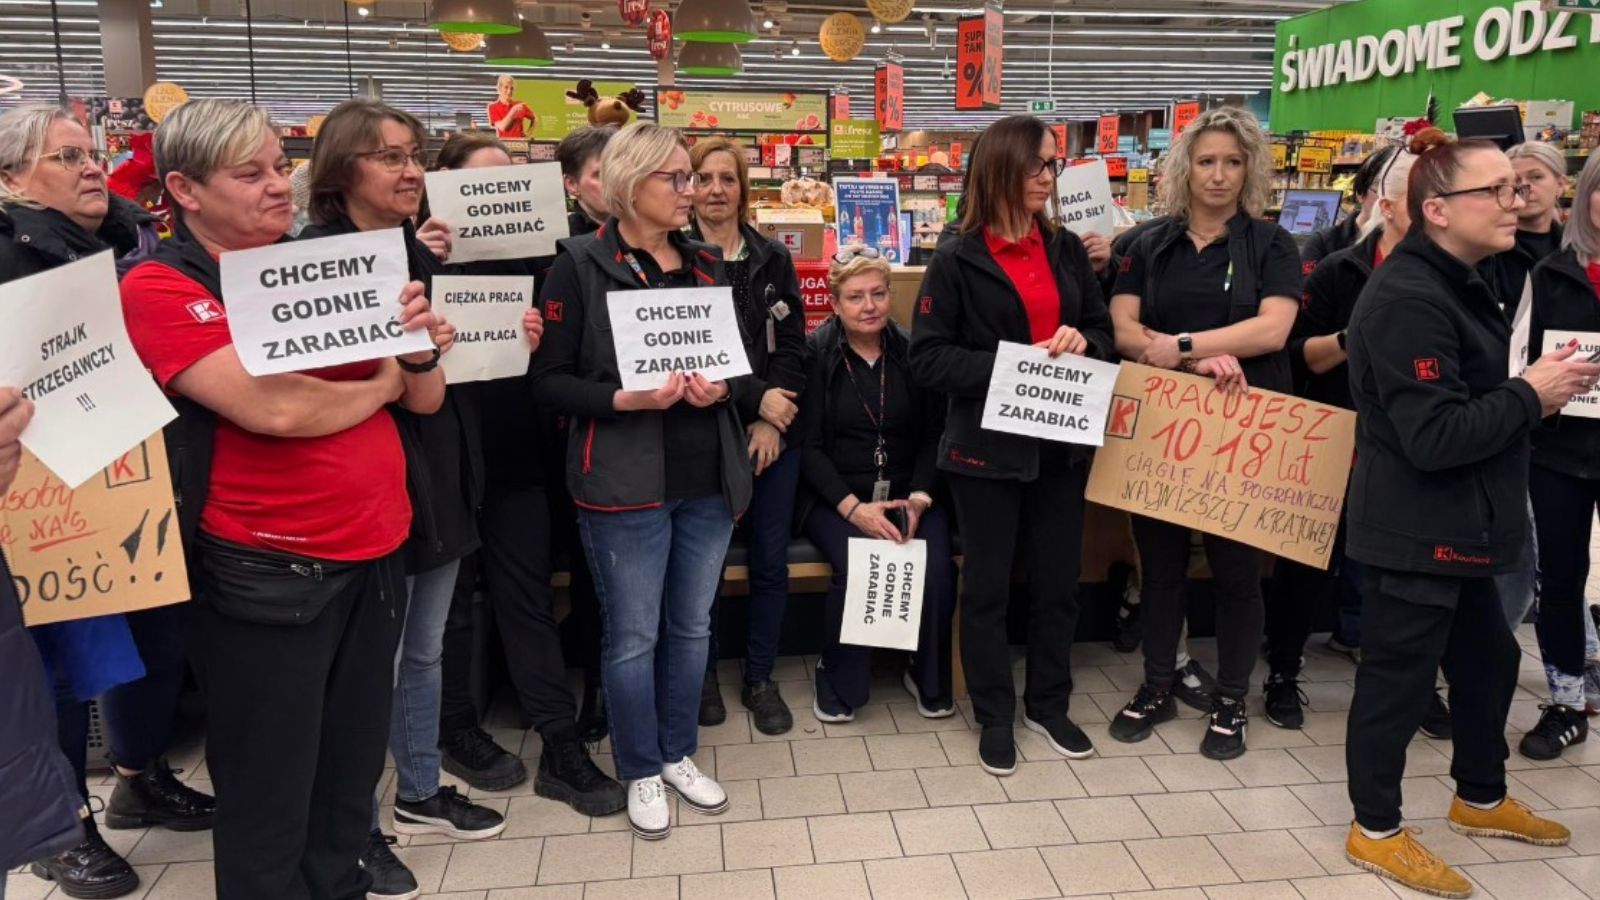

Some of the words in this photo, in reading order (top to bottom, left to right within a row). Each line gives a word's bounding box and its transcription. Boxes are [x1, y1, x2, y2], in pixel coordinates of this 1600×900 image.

[1280, 14, 1465, 94] ŚWIADOME
[708, 101, 784, 113] CYTRUSOWE
[459, 180, 532, 197] CHCEMY
[467, 201, 533, 217] GODNIE
[458, 218, 545, 239] ZARABIAĆ
[259, 254, 377, 288] CHCEMY
[271, 289, 381, 323] GODNIE
[444, 290, 486, 306] CIĘŻKA
[489, 291, 523, 303] PRACA
[635, 304, 712, 321] CHCEMY
[40, 322, 88, 361] STRAJK
[261, 316, 404, 361] ZARABIAĆ
[484, 329, 518, 342] PŁACA
[644, 329, 714, 347] GODNIE
[635, 350, 730, 374] ZARABIAĆ
[1017, 360, 1093, 385] CHCEMY
[1015, 383, 1084, 407] GODNIE
[1144, 376, 1337, 441] PRACUJESZ
[998, 403, 1090, 431] ZARABIAĆ
[1109, 399, 1136, 434] K
[1278, 440, 1314, 486] lat
[1200, 469, 1228, 495] NA
[863, 553, 880, 625] ZARABIAĆ
[882, 563, 897, 618] GODNIE
[898, 561, 914, 623] CHCEMY
